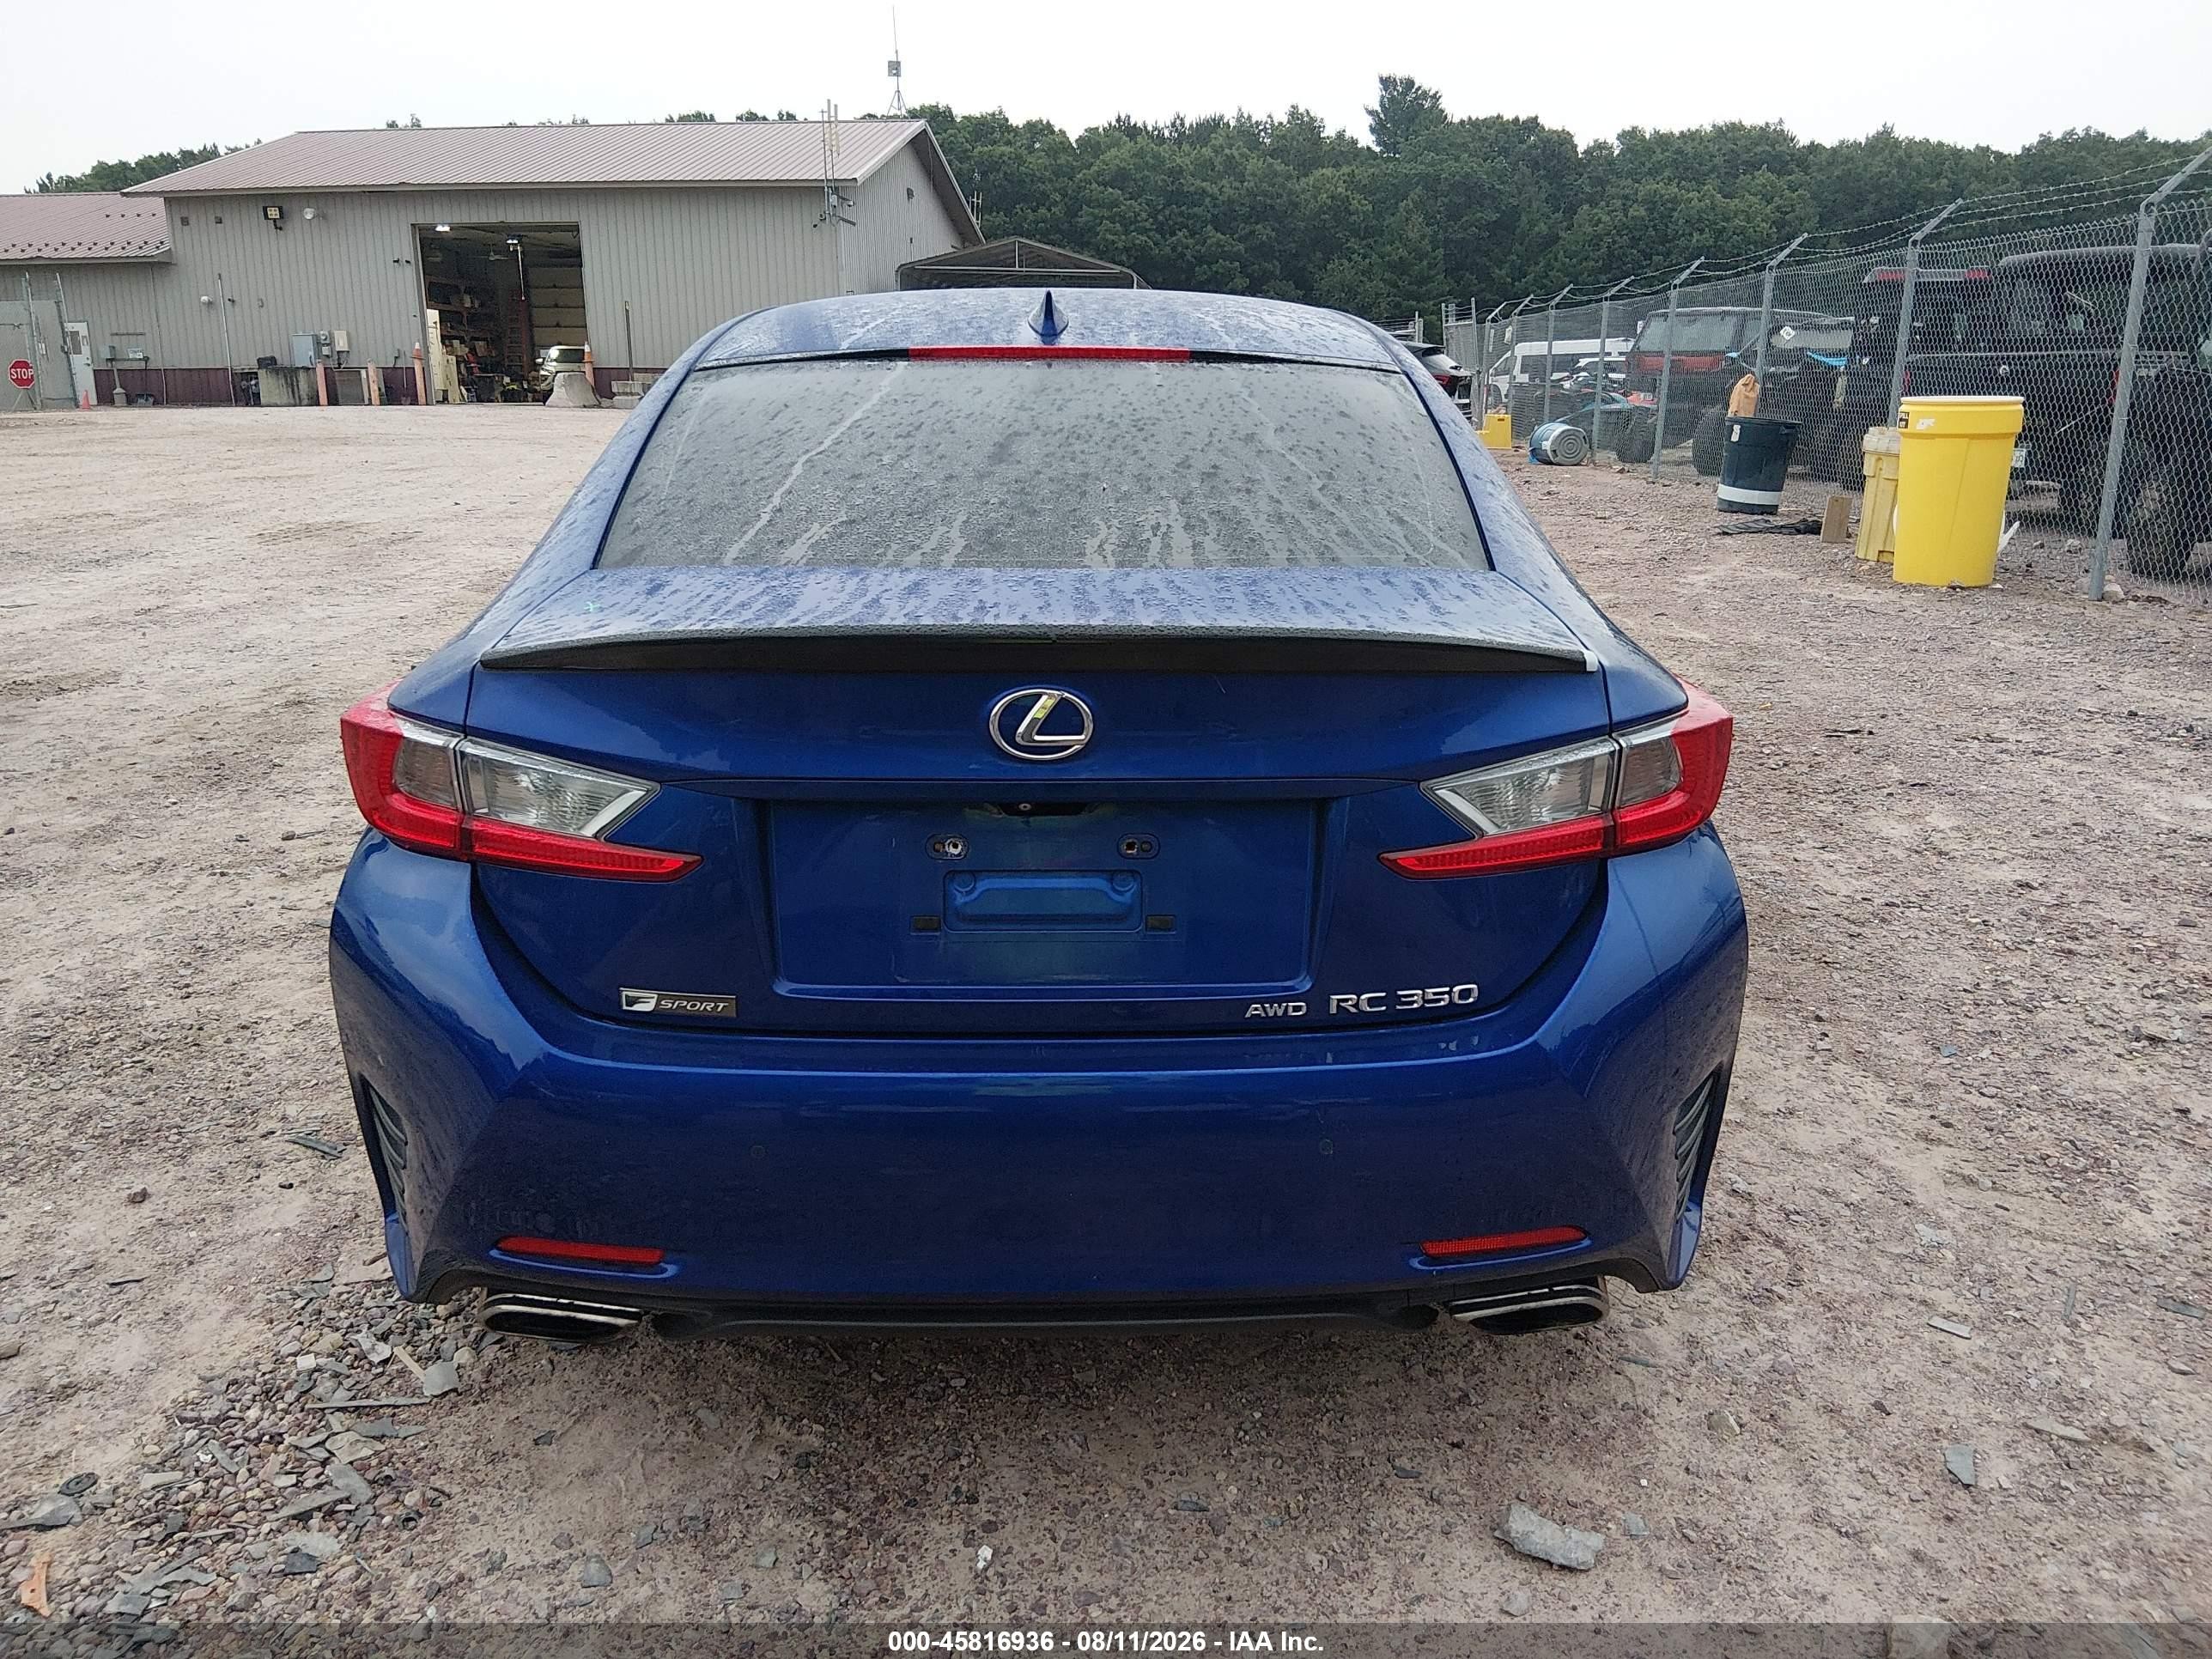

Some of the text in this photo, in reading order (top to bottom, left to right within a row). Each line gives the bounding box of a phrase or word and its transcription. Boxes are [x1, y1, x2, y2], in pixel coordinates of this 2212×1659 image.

[10, 368, 33, 380] STOP
[659, 999, 729, 1012] SPORT
[1328, 984, 1479, 1014] RC 350
[1244, 1001, 1307, 1018] AWD
